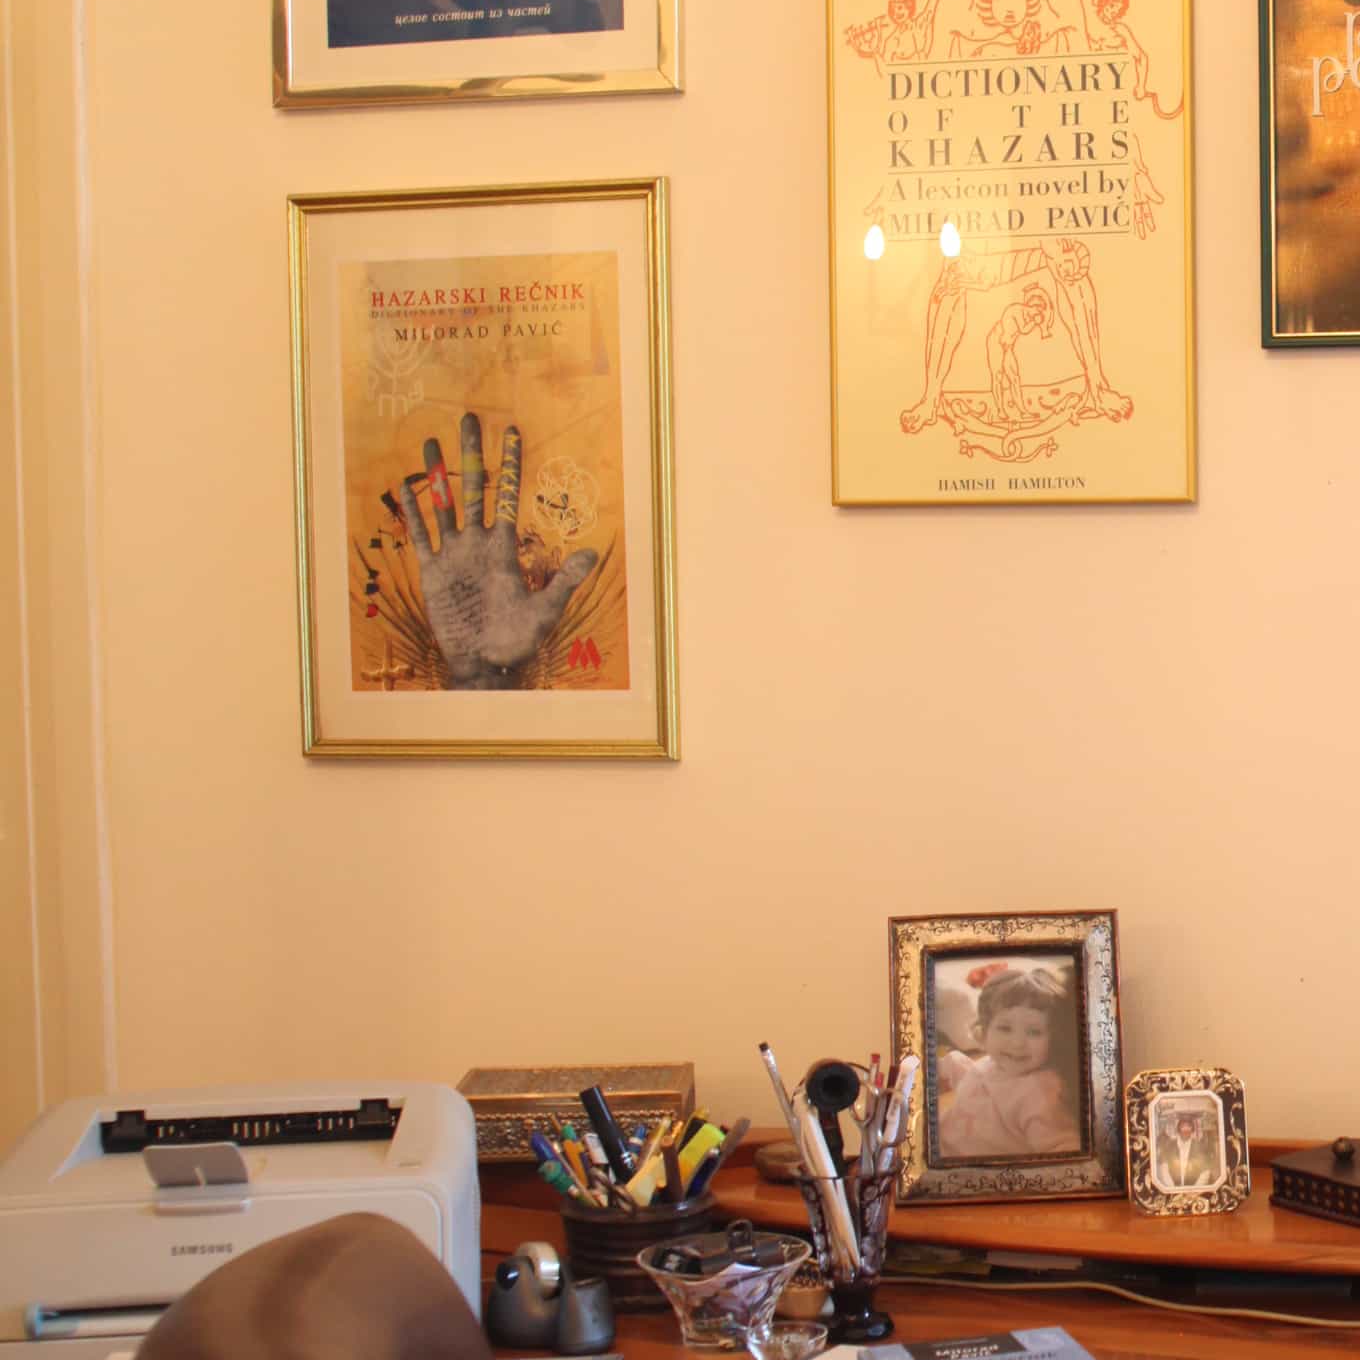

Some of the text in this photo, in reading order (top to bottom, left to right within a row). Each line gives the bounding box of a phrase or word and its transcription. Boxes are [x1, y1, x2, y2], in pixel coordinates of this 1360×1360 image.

[394, 13, 428, 26] целое
[432, 8, 485, 23] состоит
[507, 2, 552, 18] частей
[887, 61, 1130, 101] DICTIONARY
[1011, 99, 1129, 129] THE
[888, 129, 1130, 168] KHAZARS
[887, 169, 1130, 202] A lexicon novel by
[887, 195, 1131, 236] MILORAD PAVIĆ
[370, 280, 586, 309] HAZARSKI REČNIK
[394, 319, 564, 343] MILORAD PAVIĆ
[938, 475, 1087, 492] HAMISH HAMILTON
[171, 1242, 233, 1257] SAMSUNG
